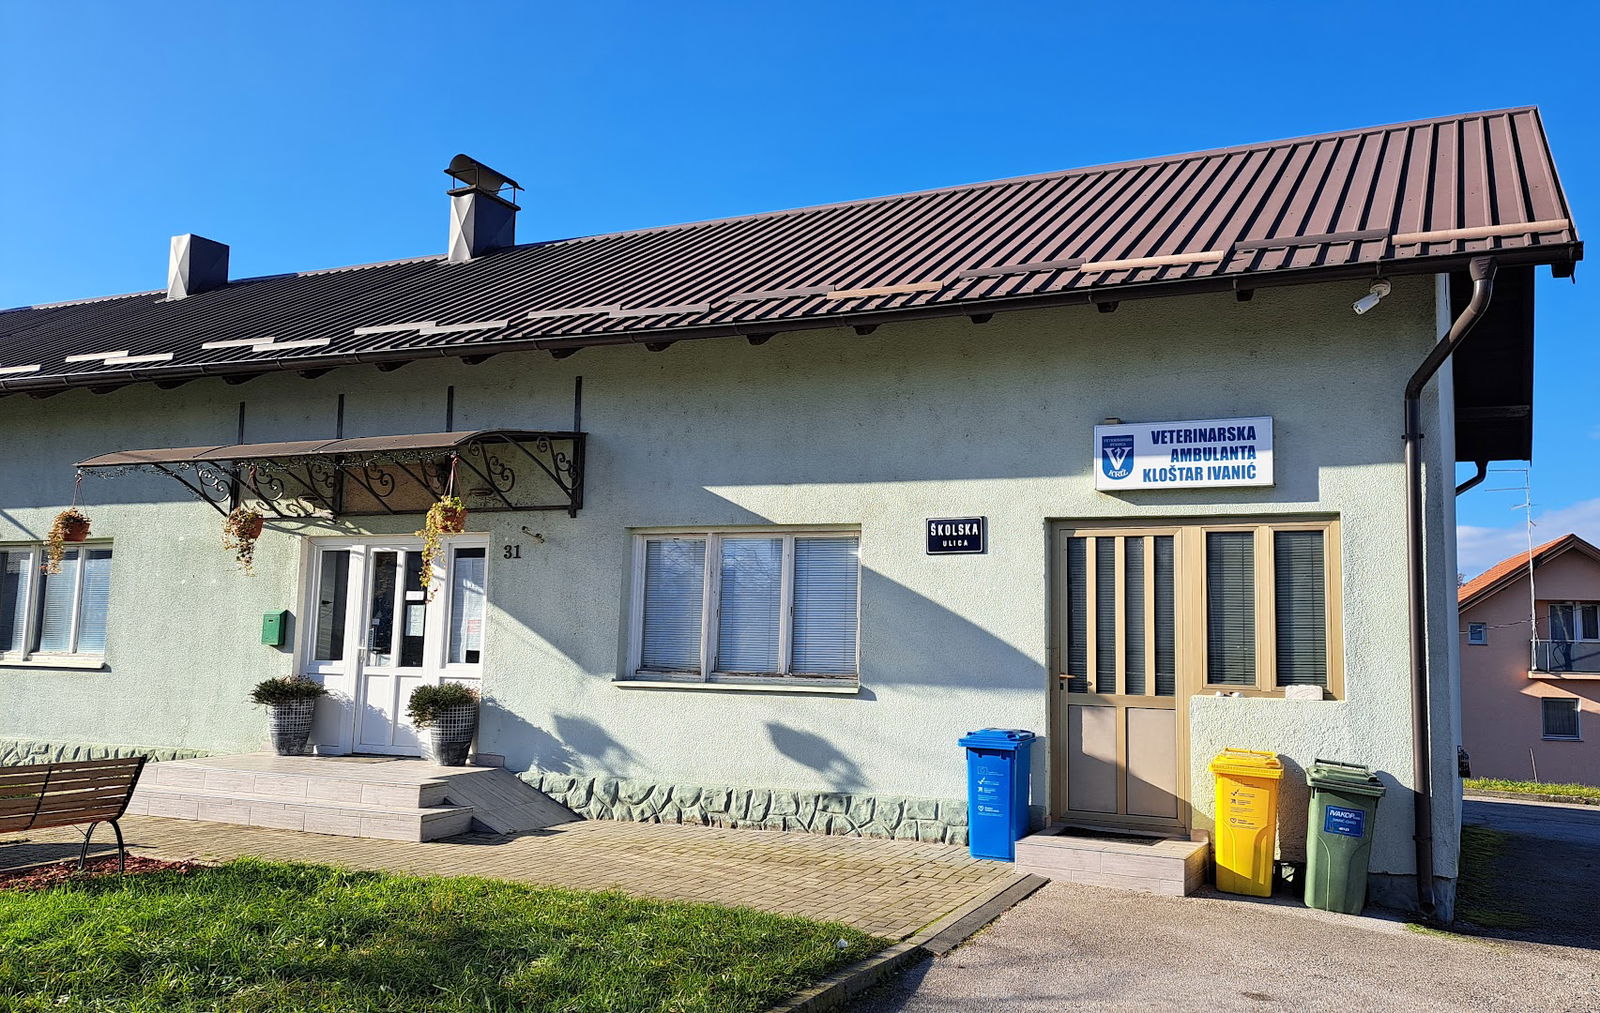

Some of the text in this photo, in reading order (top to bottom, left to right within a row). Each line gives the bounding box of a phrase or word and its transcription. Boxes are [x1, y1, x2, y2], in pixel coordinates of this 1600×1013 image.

[1151, 425, 1257, 445] VETERINARSKA
[1170, 445, 1257, 463] AMBULANTA
[1143, 462, 1256, 483] KLOŠTAR IVANIĆ
[930, 523, 979, 536] ŠKOLSKA
[503, 544, 522, 560] 31
